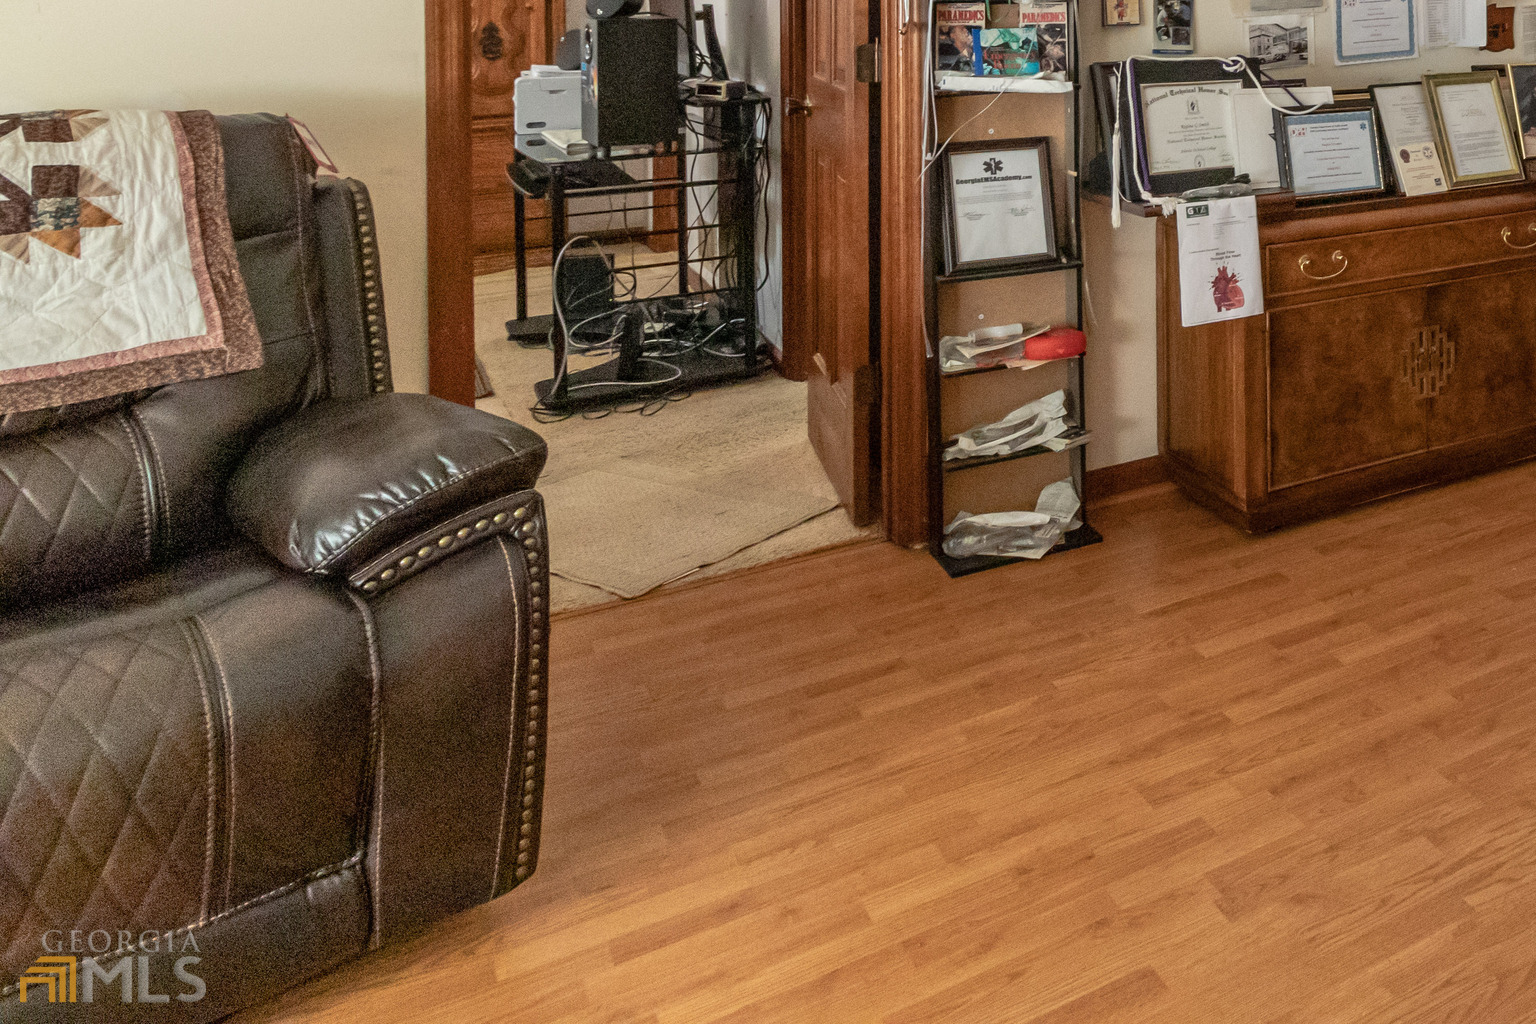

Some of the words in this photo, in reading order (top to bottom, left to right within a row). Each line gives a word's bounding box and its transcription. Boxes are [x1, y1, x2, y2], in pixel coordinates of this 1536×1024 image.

[937, 10, 985, 23] PARAMEDICS
[1022, 12, 1066, 23] PARAMEDICS
[1169, 87, 1197, 96] Technical
[1187, 206, 1207, 215] GTA
